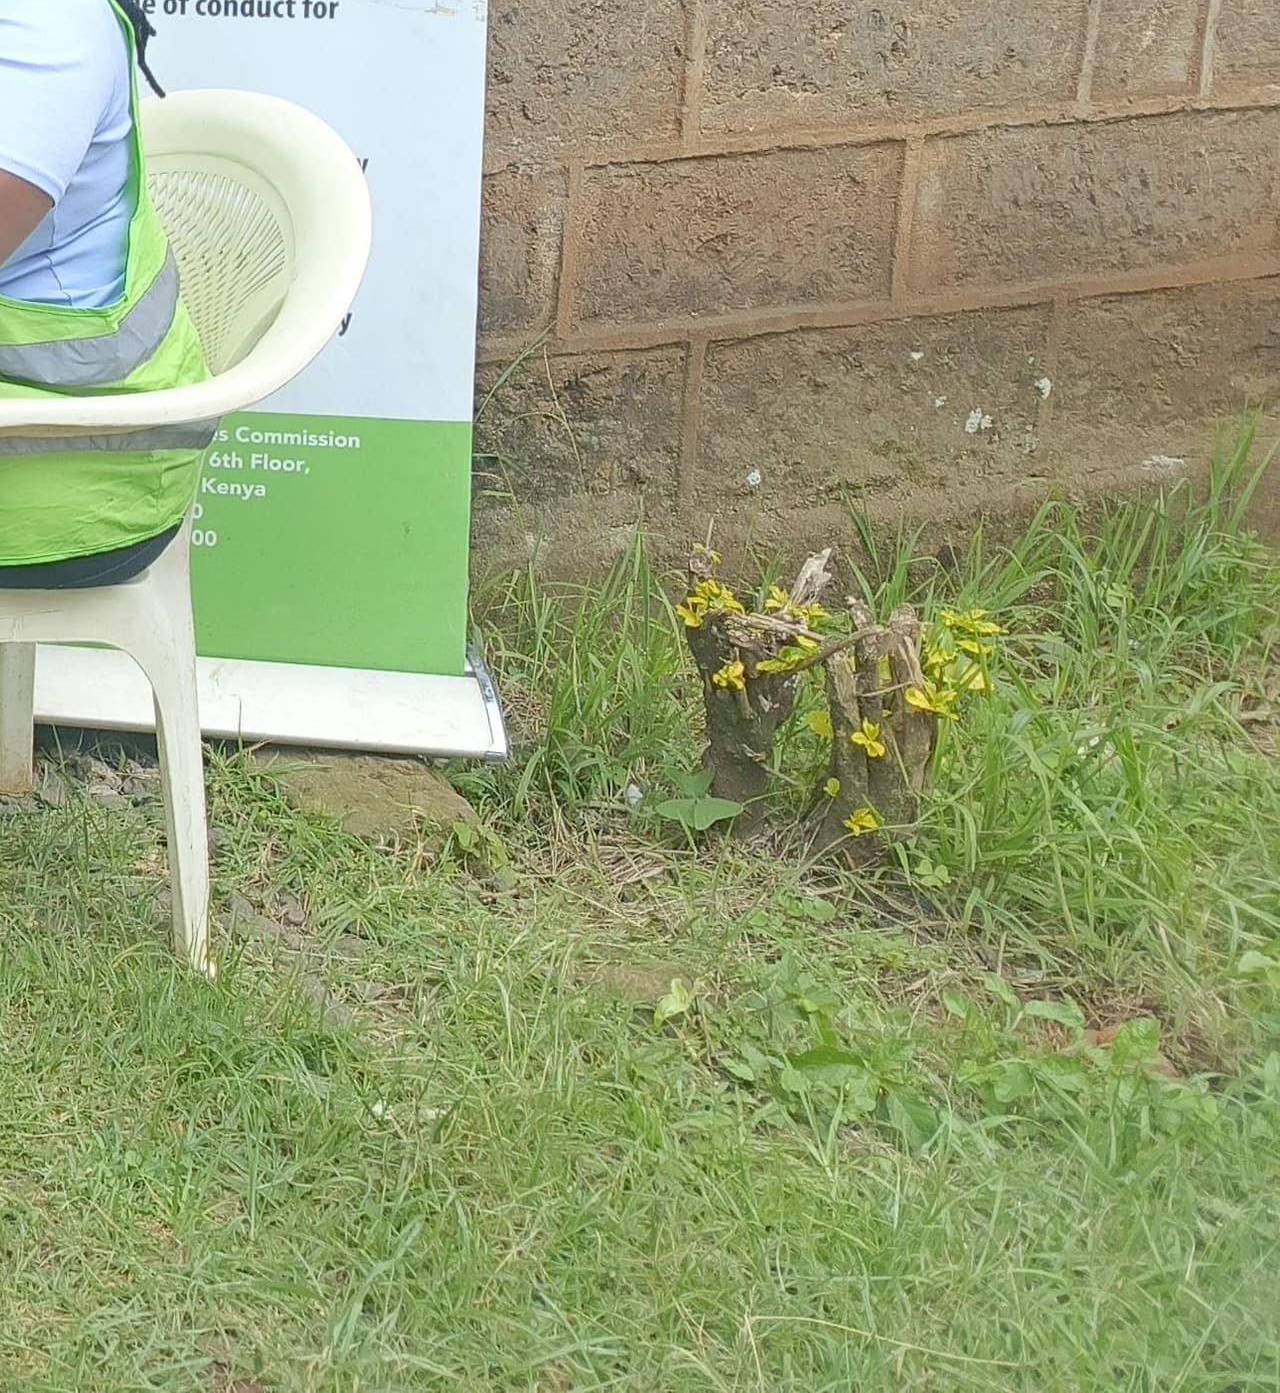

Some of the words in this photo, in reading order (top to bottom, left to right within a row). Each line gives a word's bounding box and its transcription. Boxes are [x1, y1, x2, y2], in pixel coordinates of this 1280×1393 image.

[235, 426, 361, 448] Commission
[209, 451, 243, 469] 6th
[250, 453, 311, 475] Floor,
[201, 477, 266, 500] Kenya
